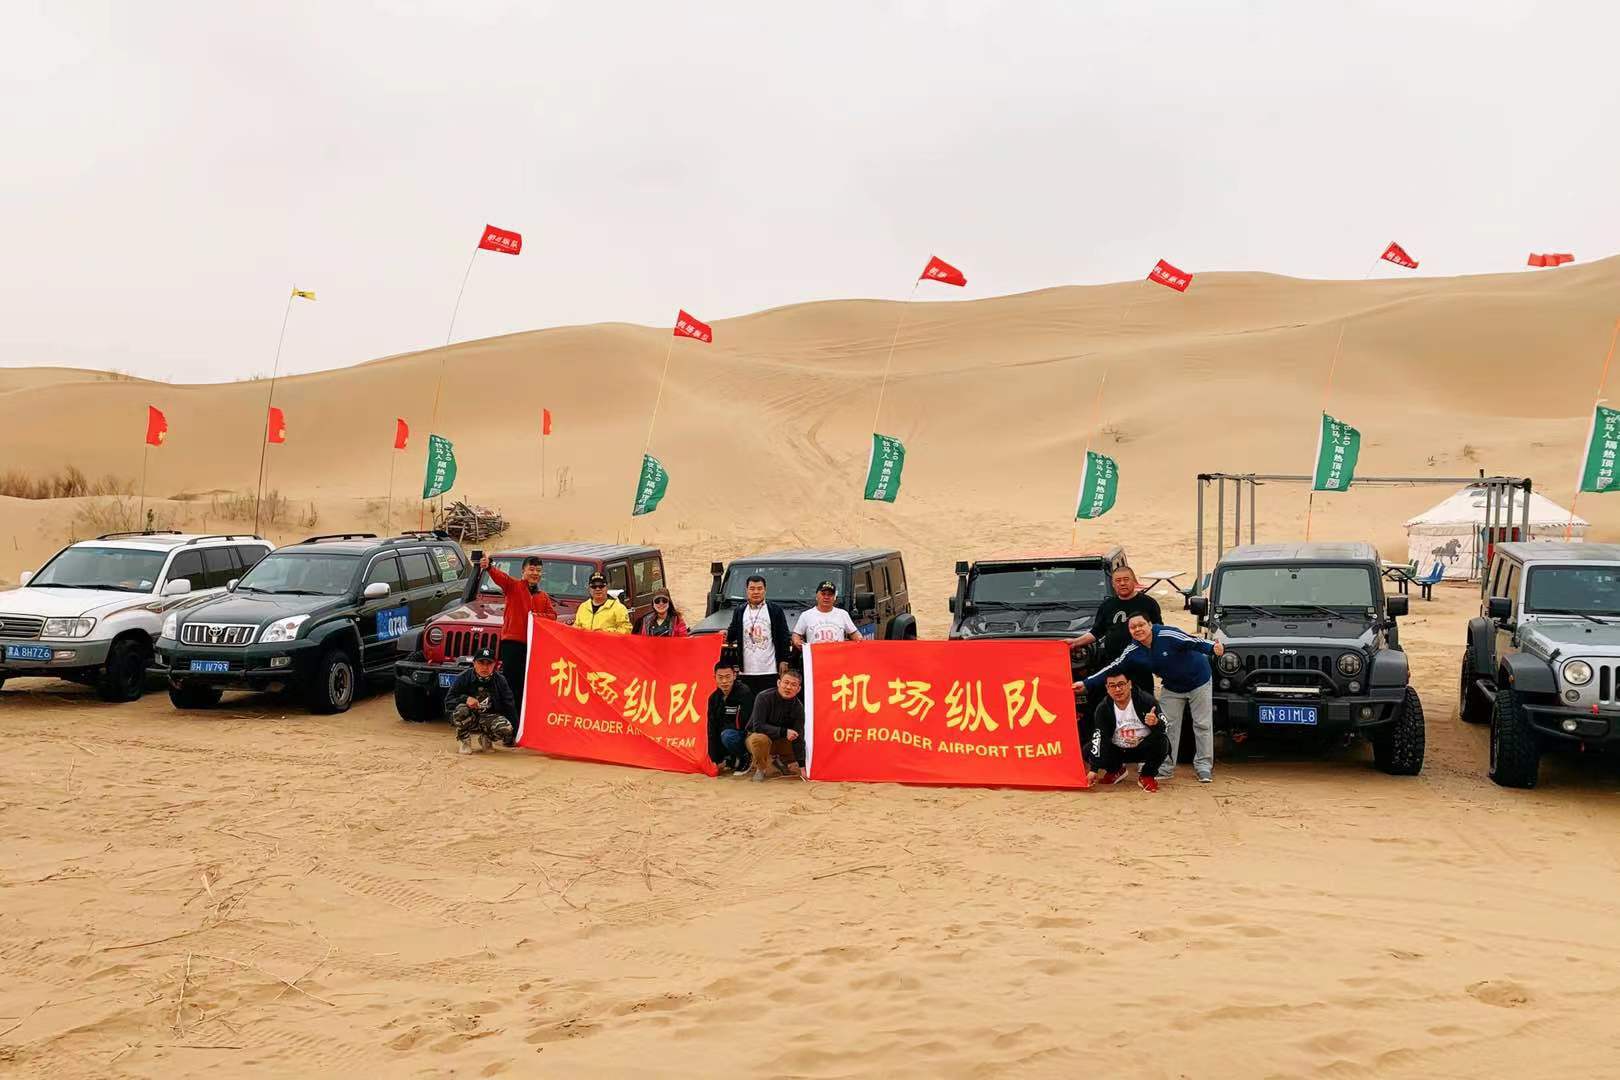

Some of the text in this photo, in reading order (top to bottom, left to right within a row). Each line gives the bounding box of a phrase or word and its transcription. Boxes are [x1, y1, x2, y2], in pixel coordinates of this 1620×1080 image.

[1279, 648, 1298, 656] Jeep
[550, 657, 701, 726] 机场纵队
[831, 673, 1057, 733] 机场纵队
[547, 712, 572, 726] OFF
[574, 715, 624, 735] ROADER
[665, 736, 697, 748] TEAM
[833, 727, 1063, 758] OFF ROADER AIRPORT TEAM
